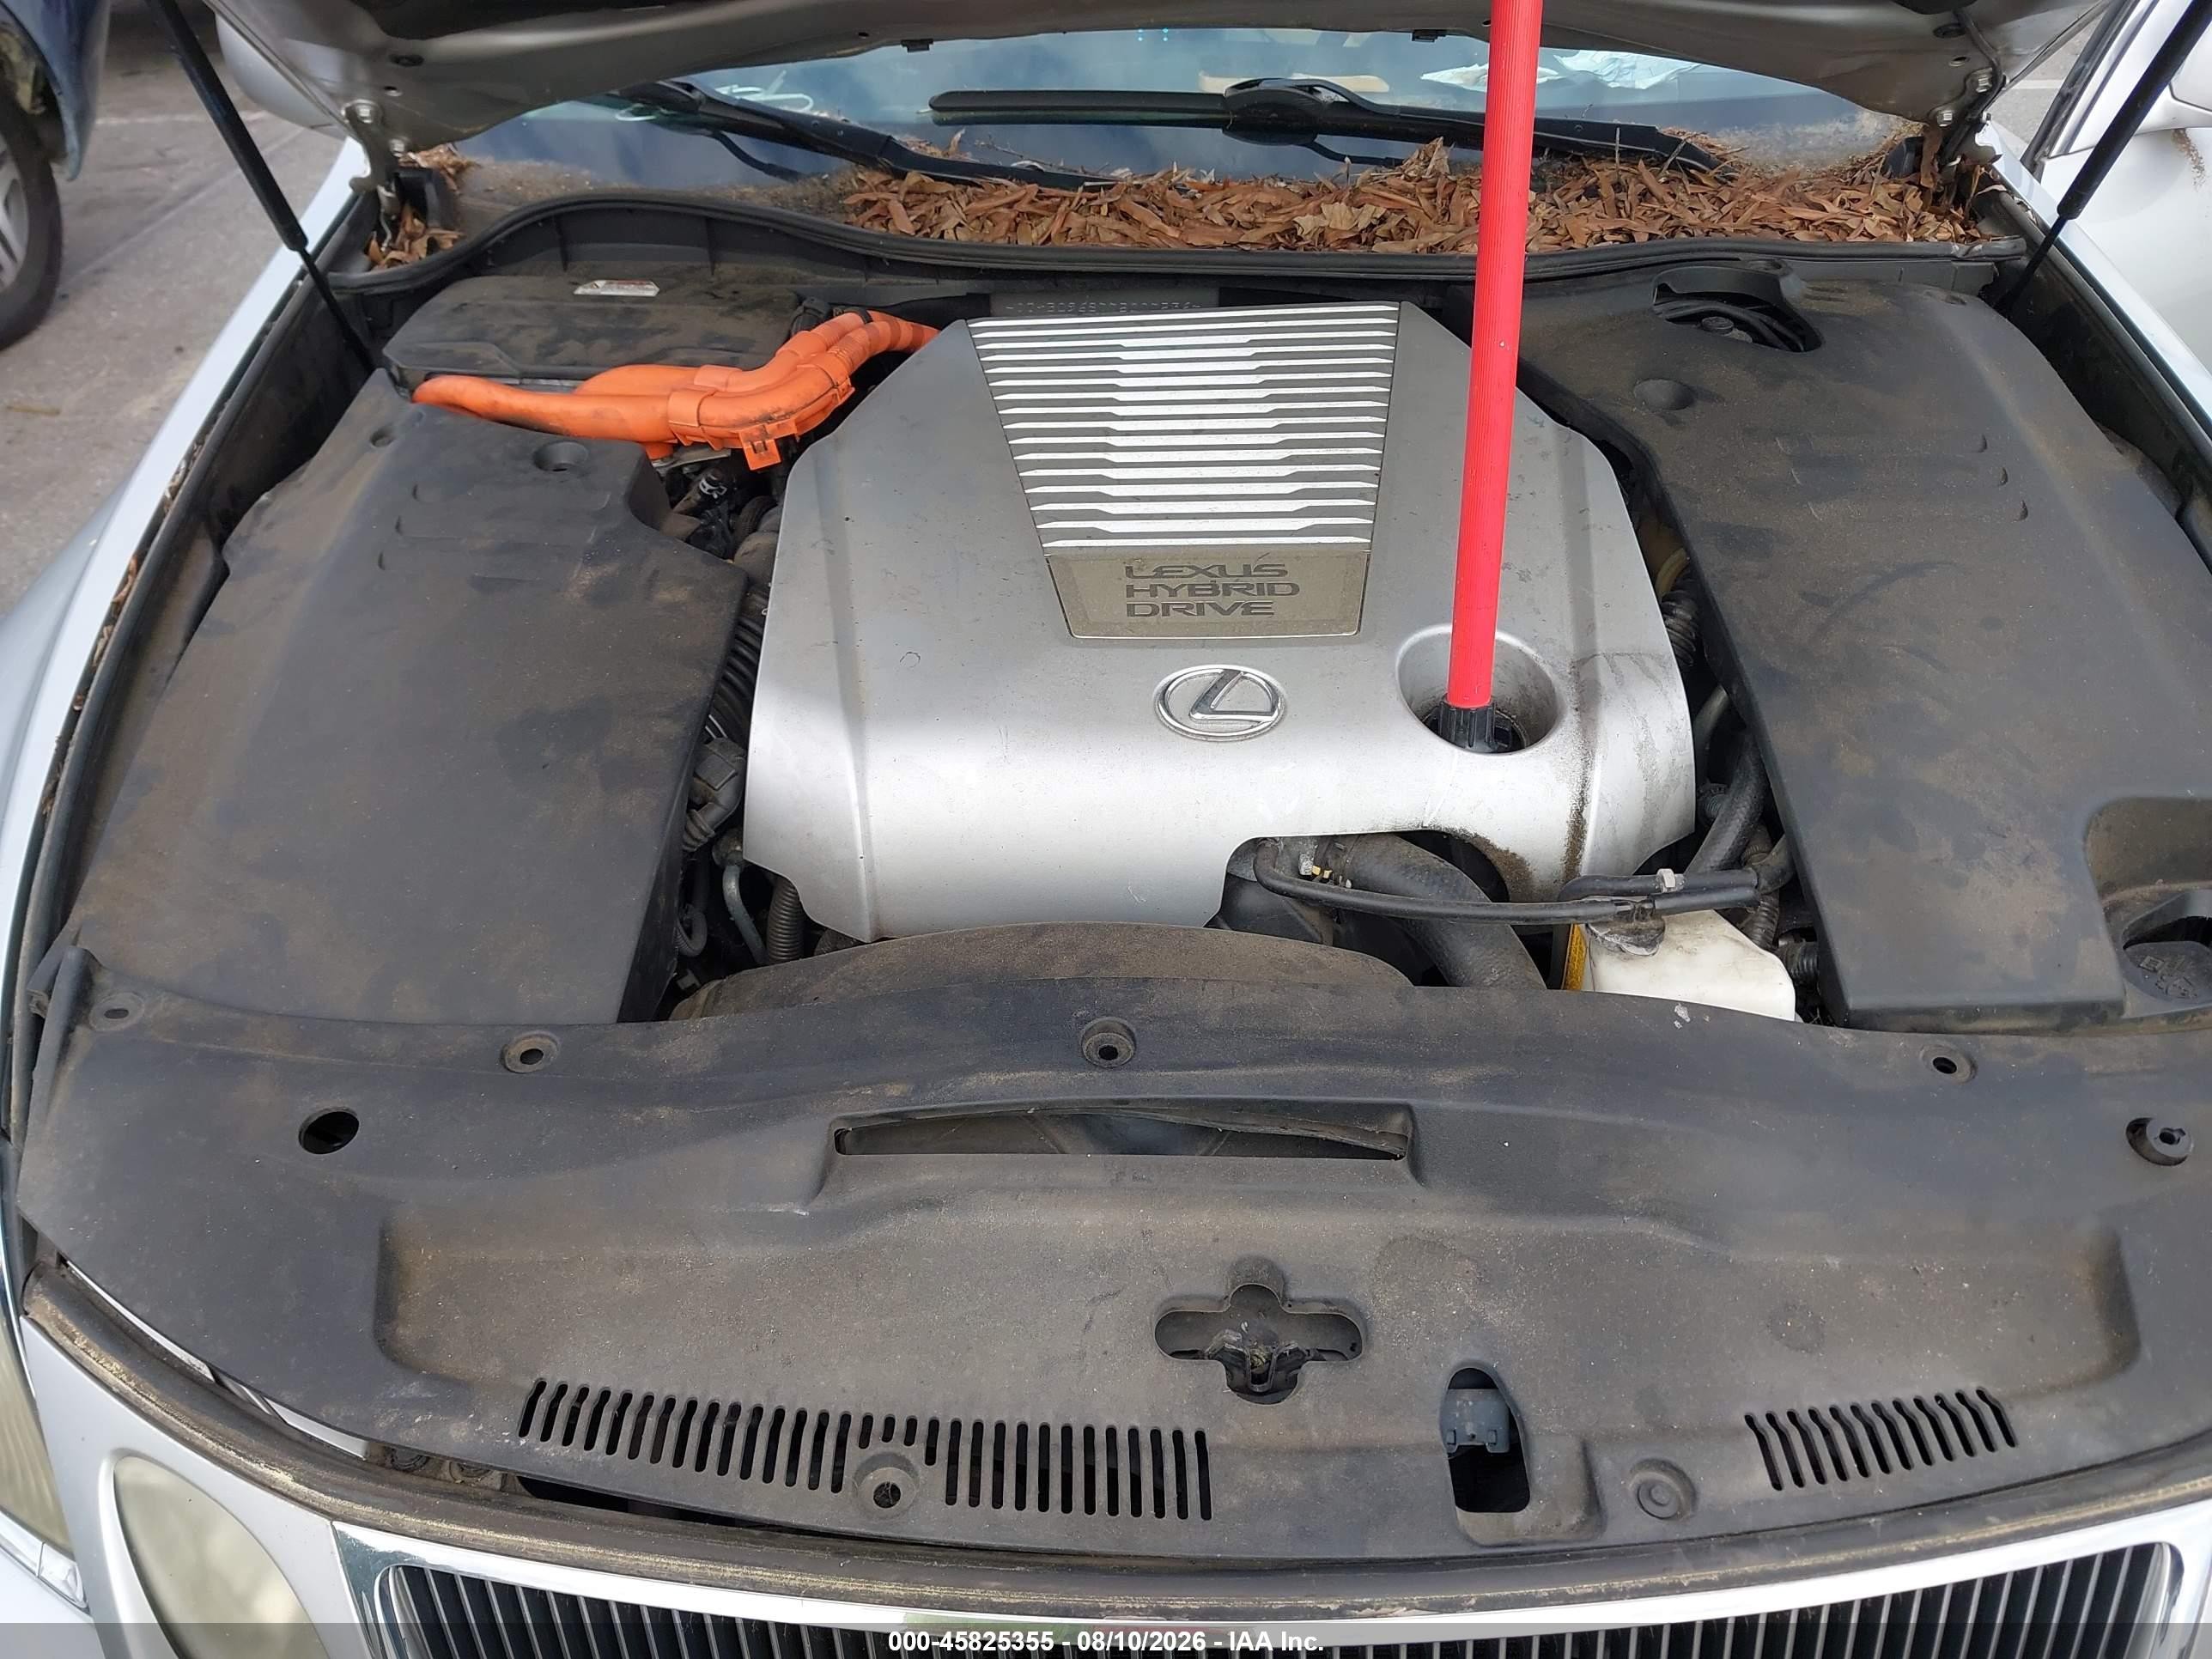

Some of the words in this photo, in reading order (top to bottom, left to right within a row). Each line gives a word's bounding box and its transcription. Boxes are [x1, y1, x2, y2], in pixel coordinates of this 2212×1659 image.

[1125, 563, 1288, 579] LEXUS
[1126, 582, 1300, 598] HYBRID
[1126, 602, 1274, 617] DRIVE
